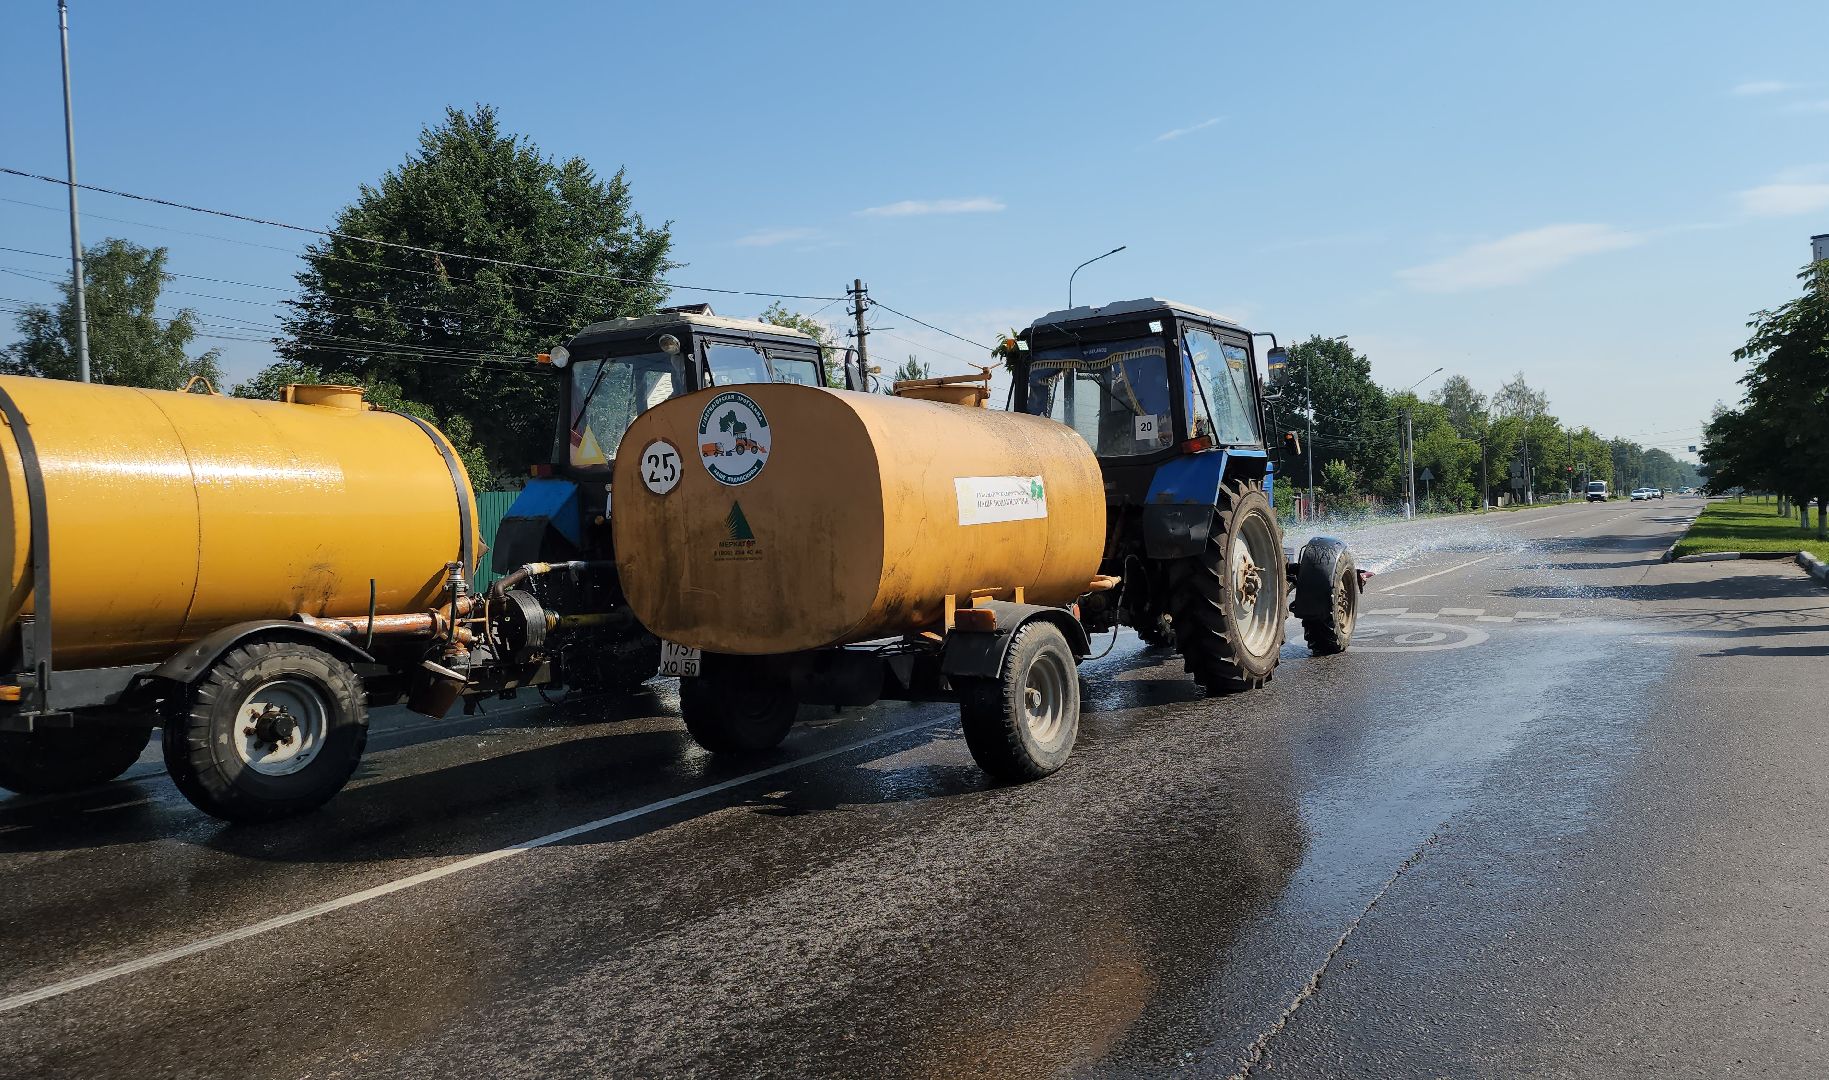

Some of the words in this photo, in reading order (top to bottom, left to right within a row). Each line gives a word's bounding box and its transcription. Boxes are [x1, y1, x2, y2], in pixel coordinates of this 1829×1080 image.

[1140, 421, 1152, 431] 20
[647, 452, 676, 483] 25
[684, 662, 697, 674] 50
